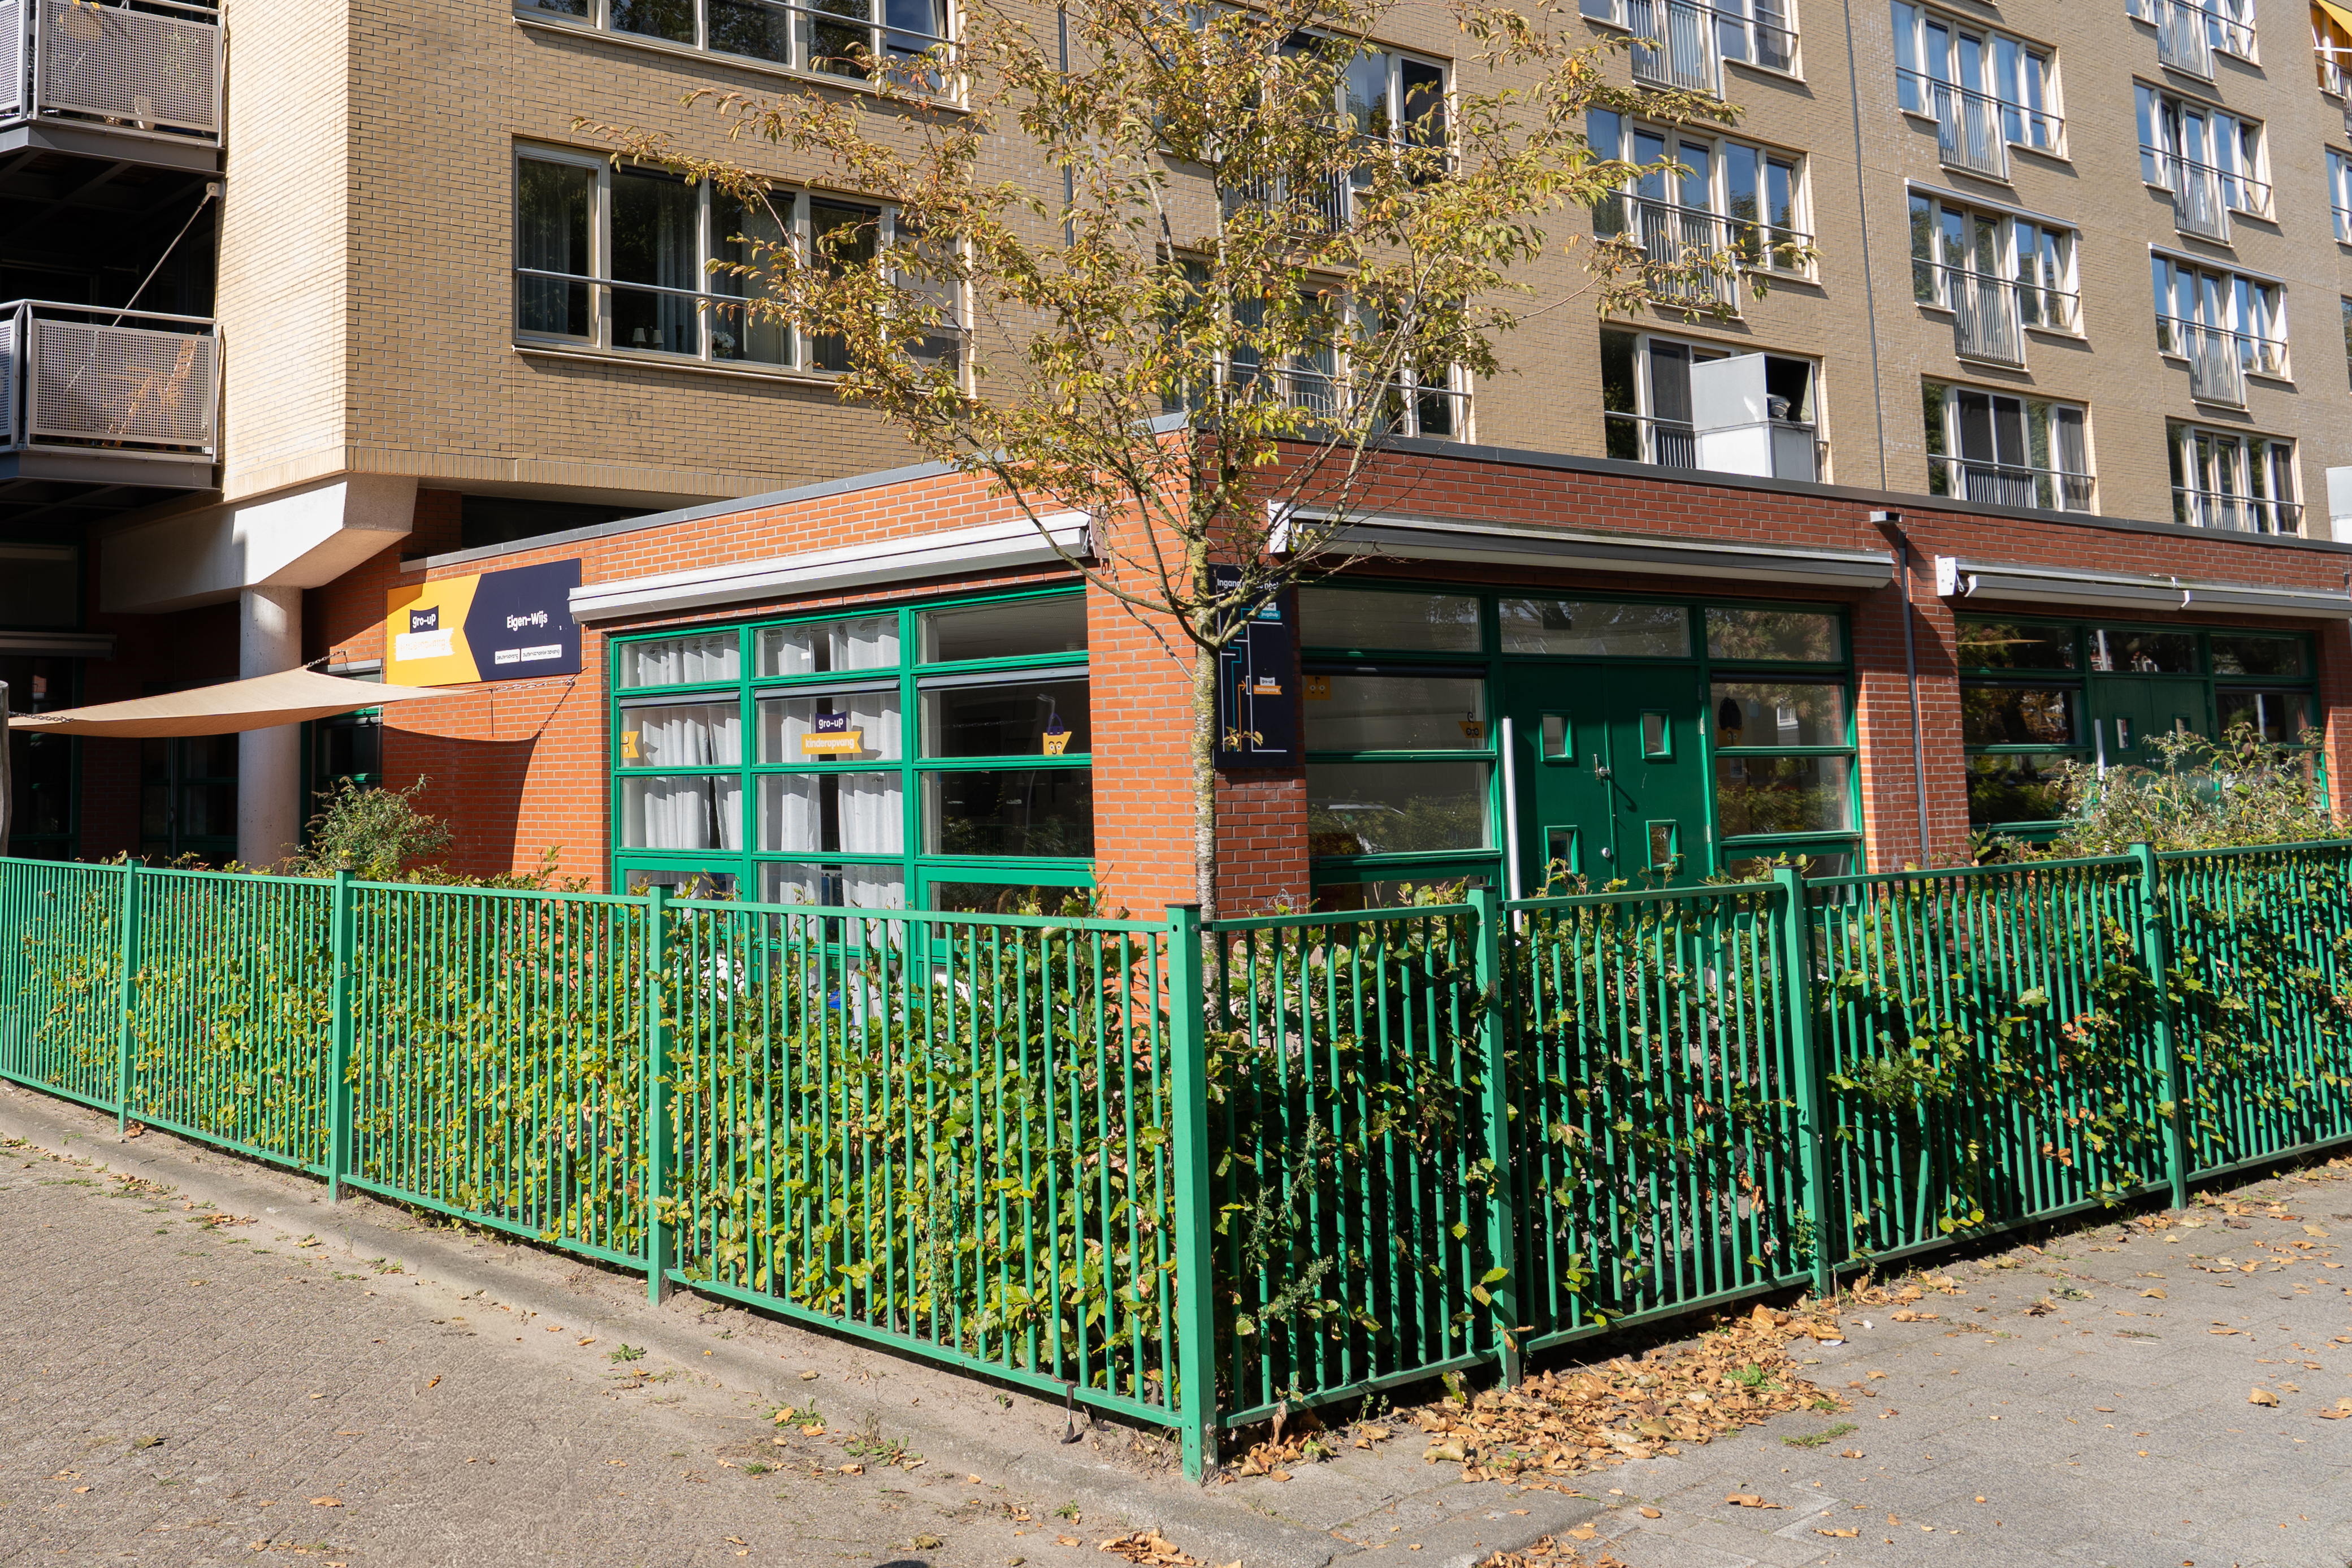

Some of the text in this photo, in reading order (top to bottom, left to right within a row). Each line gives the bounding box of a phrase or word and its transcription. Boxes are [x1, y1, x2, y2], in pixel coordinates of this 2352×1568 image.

[1217, 578, 1241, 590] Ingang
[412, 613, 436, 629] gro-up
[506, 610, 548, 631] Eigen-Wijs
[818, 717, 843, 729] gro-up
[805, 738, 854, 750] kinderopvang
